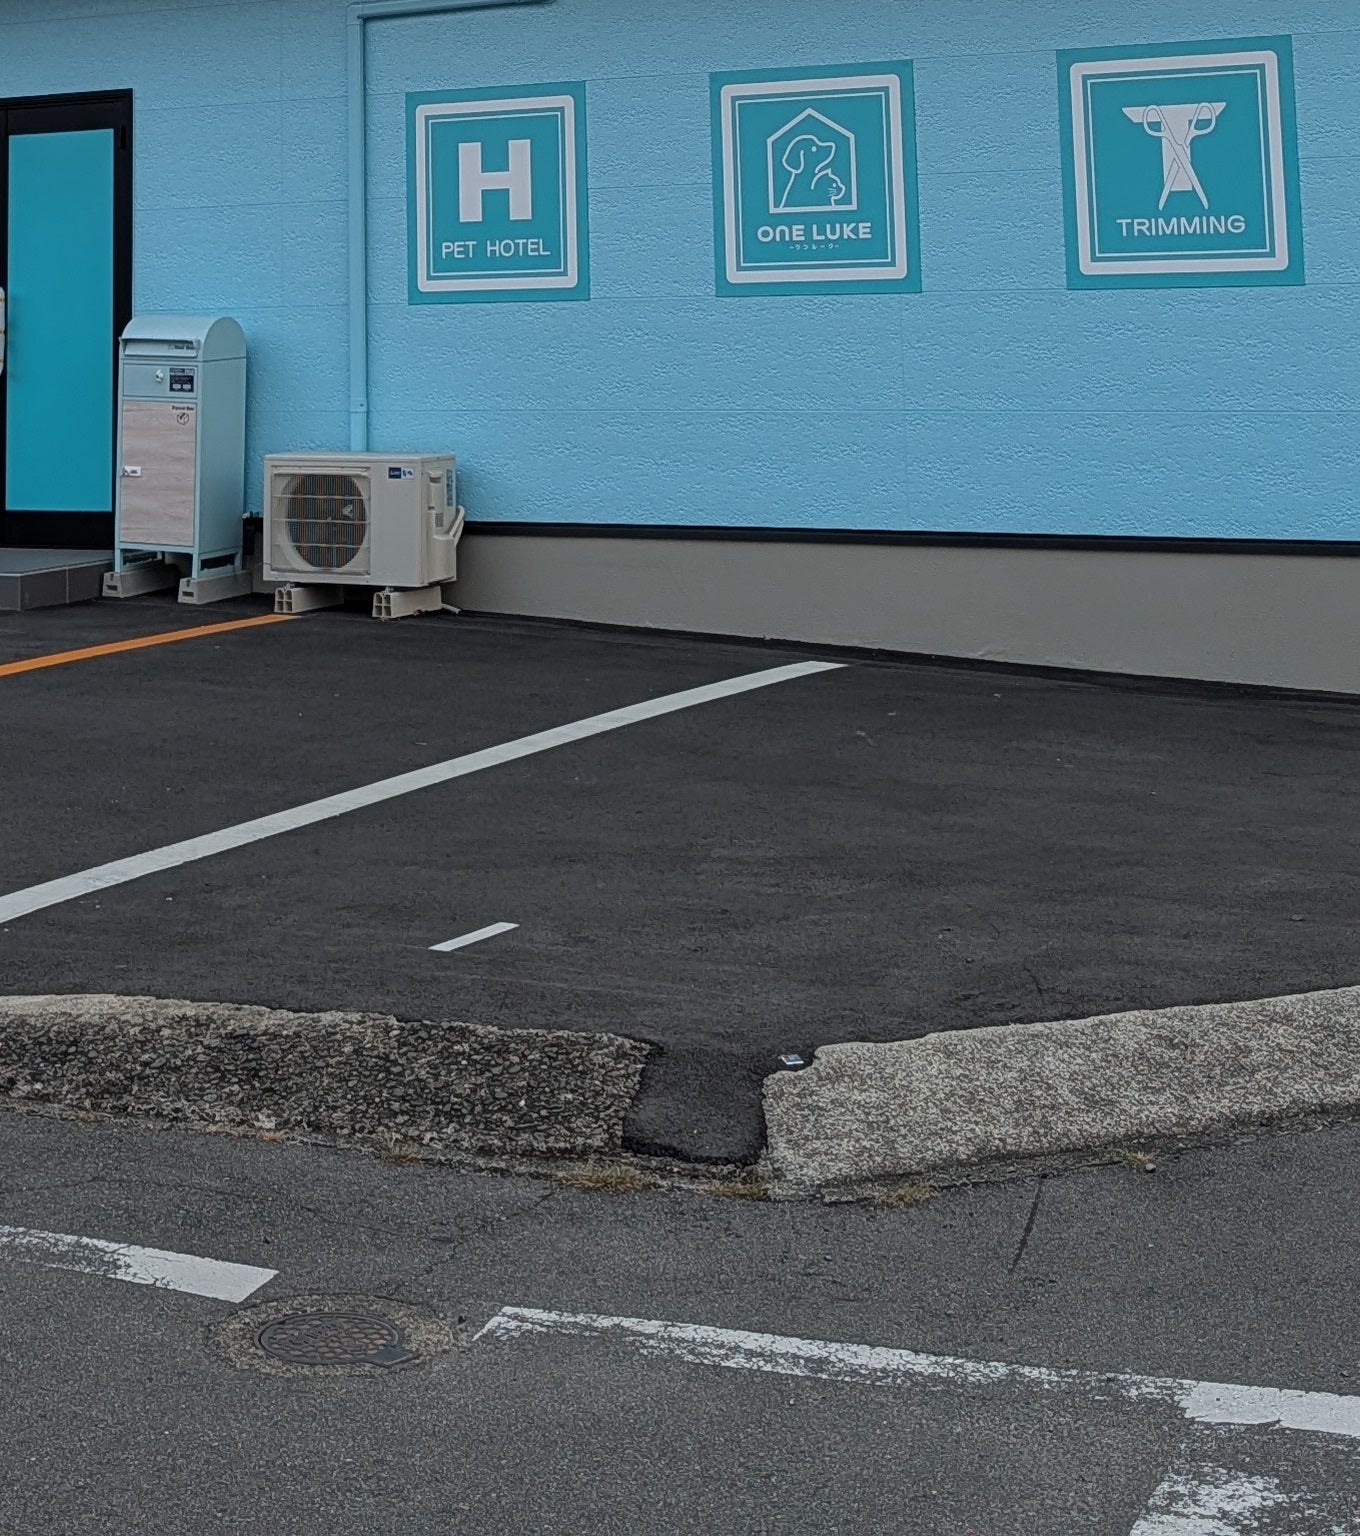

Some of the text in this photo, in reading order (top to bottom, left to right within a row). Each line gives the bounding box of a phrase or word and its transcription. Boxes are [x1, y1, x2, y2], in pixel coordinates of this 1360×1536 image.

[458, 139, 532, 222] H
[757, 222, 872, 242] ONE LUKE
[1116, 215, 1246, 237] TRIMMING
[442, 238, 551, 259] PET HOTEL
